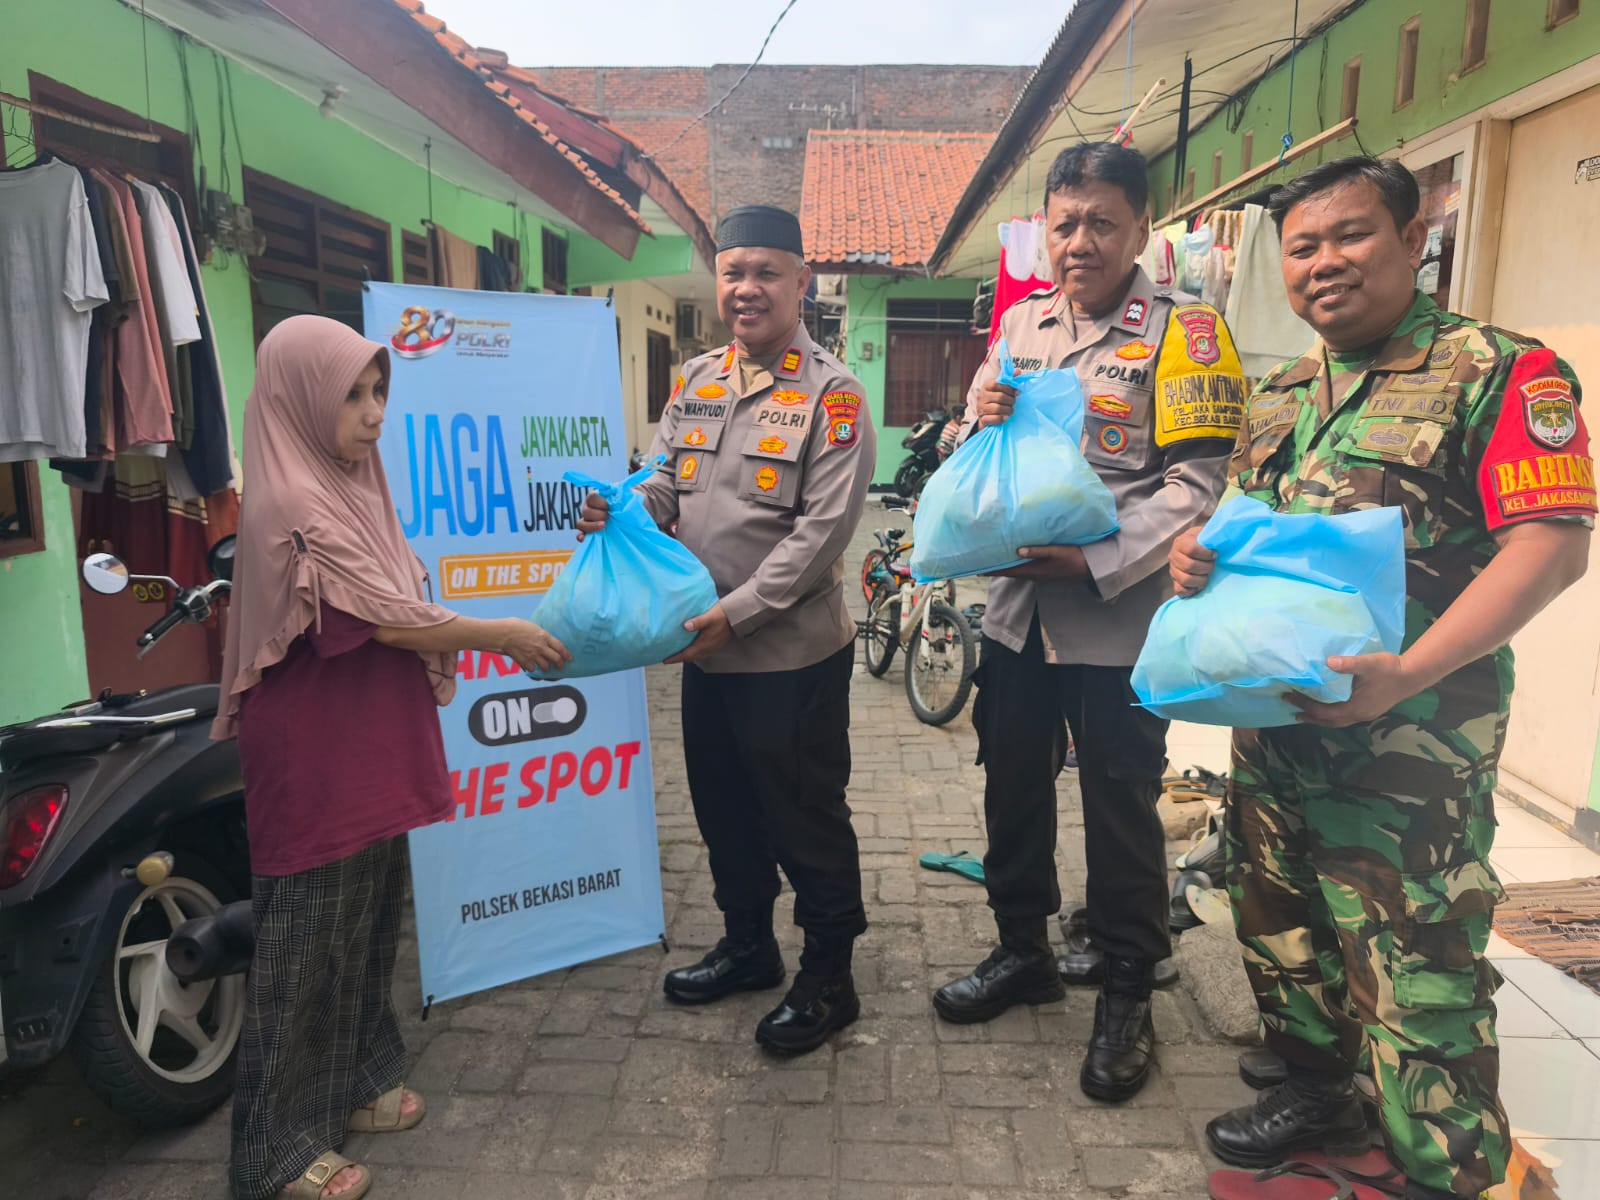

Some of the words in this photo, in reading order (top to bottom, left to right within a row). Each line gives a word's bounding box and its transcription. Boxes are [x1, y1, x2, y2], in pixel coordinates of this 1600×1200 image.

[456, 332, 511, 348] POLRI
[1094, 364, 1149, 385] POLRI
[684, 402, 726, 418] WAHYUDI
[758, 410, 806, 428] POLRI
[1372, 398, 1406, 412] TNI
[1409, 399, 1448, 415] AD
[520, 416, 611, 457] JAYAKARTA
[397, 412, 518, 539] JAGA
[1495, 454, 1596, 497] BABINS
[524, 474, 589, 532] JAKAR
[452, 566, 478, 589] ON
[486, 564, 521, 587] THE
[527, 561, 567, 584] SPO
[481, 696, 532, 740] ON
[445, 761, 510, 823] HE
[517, 740, 641, 810] SPOT
[461, 892, 519, 924] POLSEK
[522, 879, 574, 909] BEKASI
[577, 868, 622, 897] BARAT
